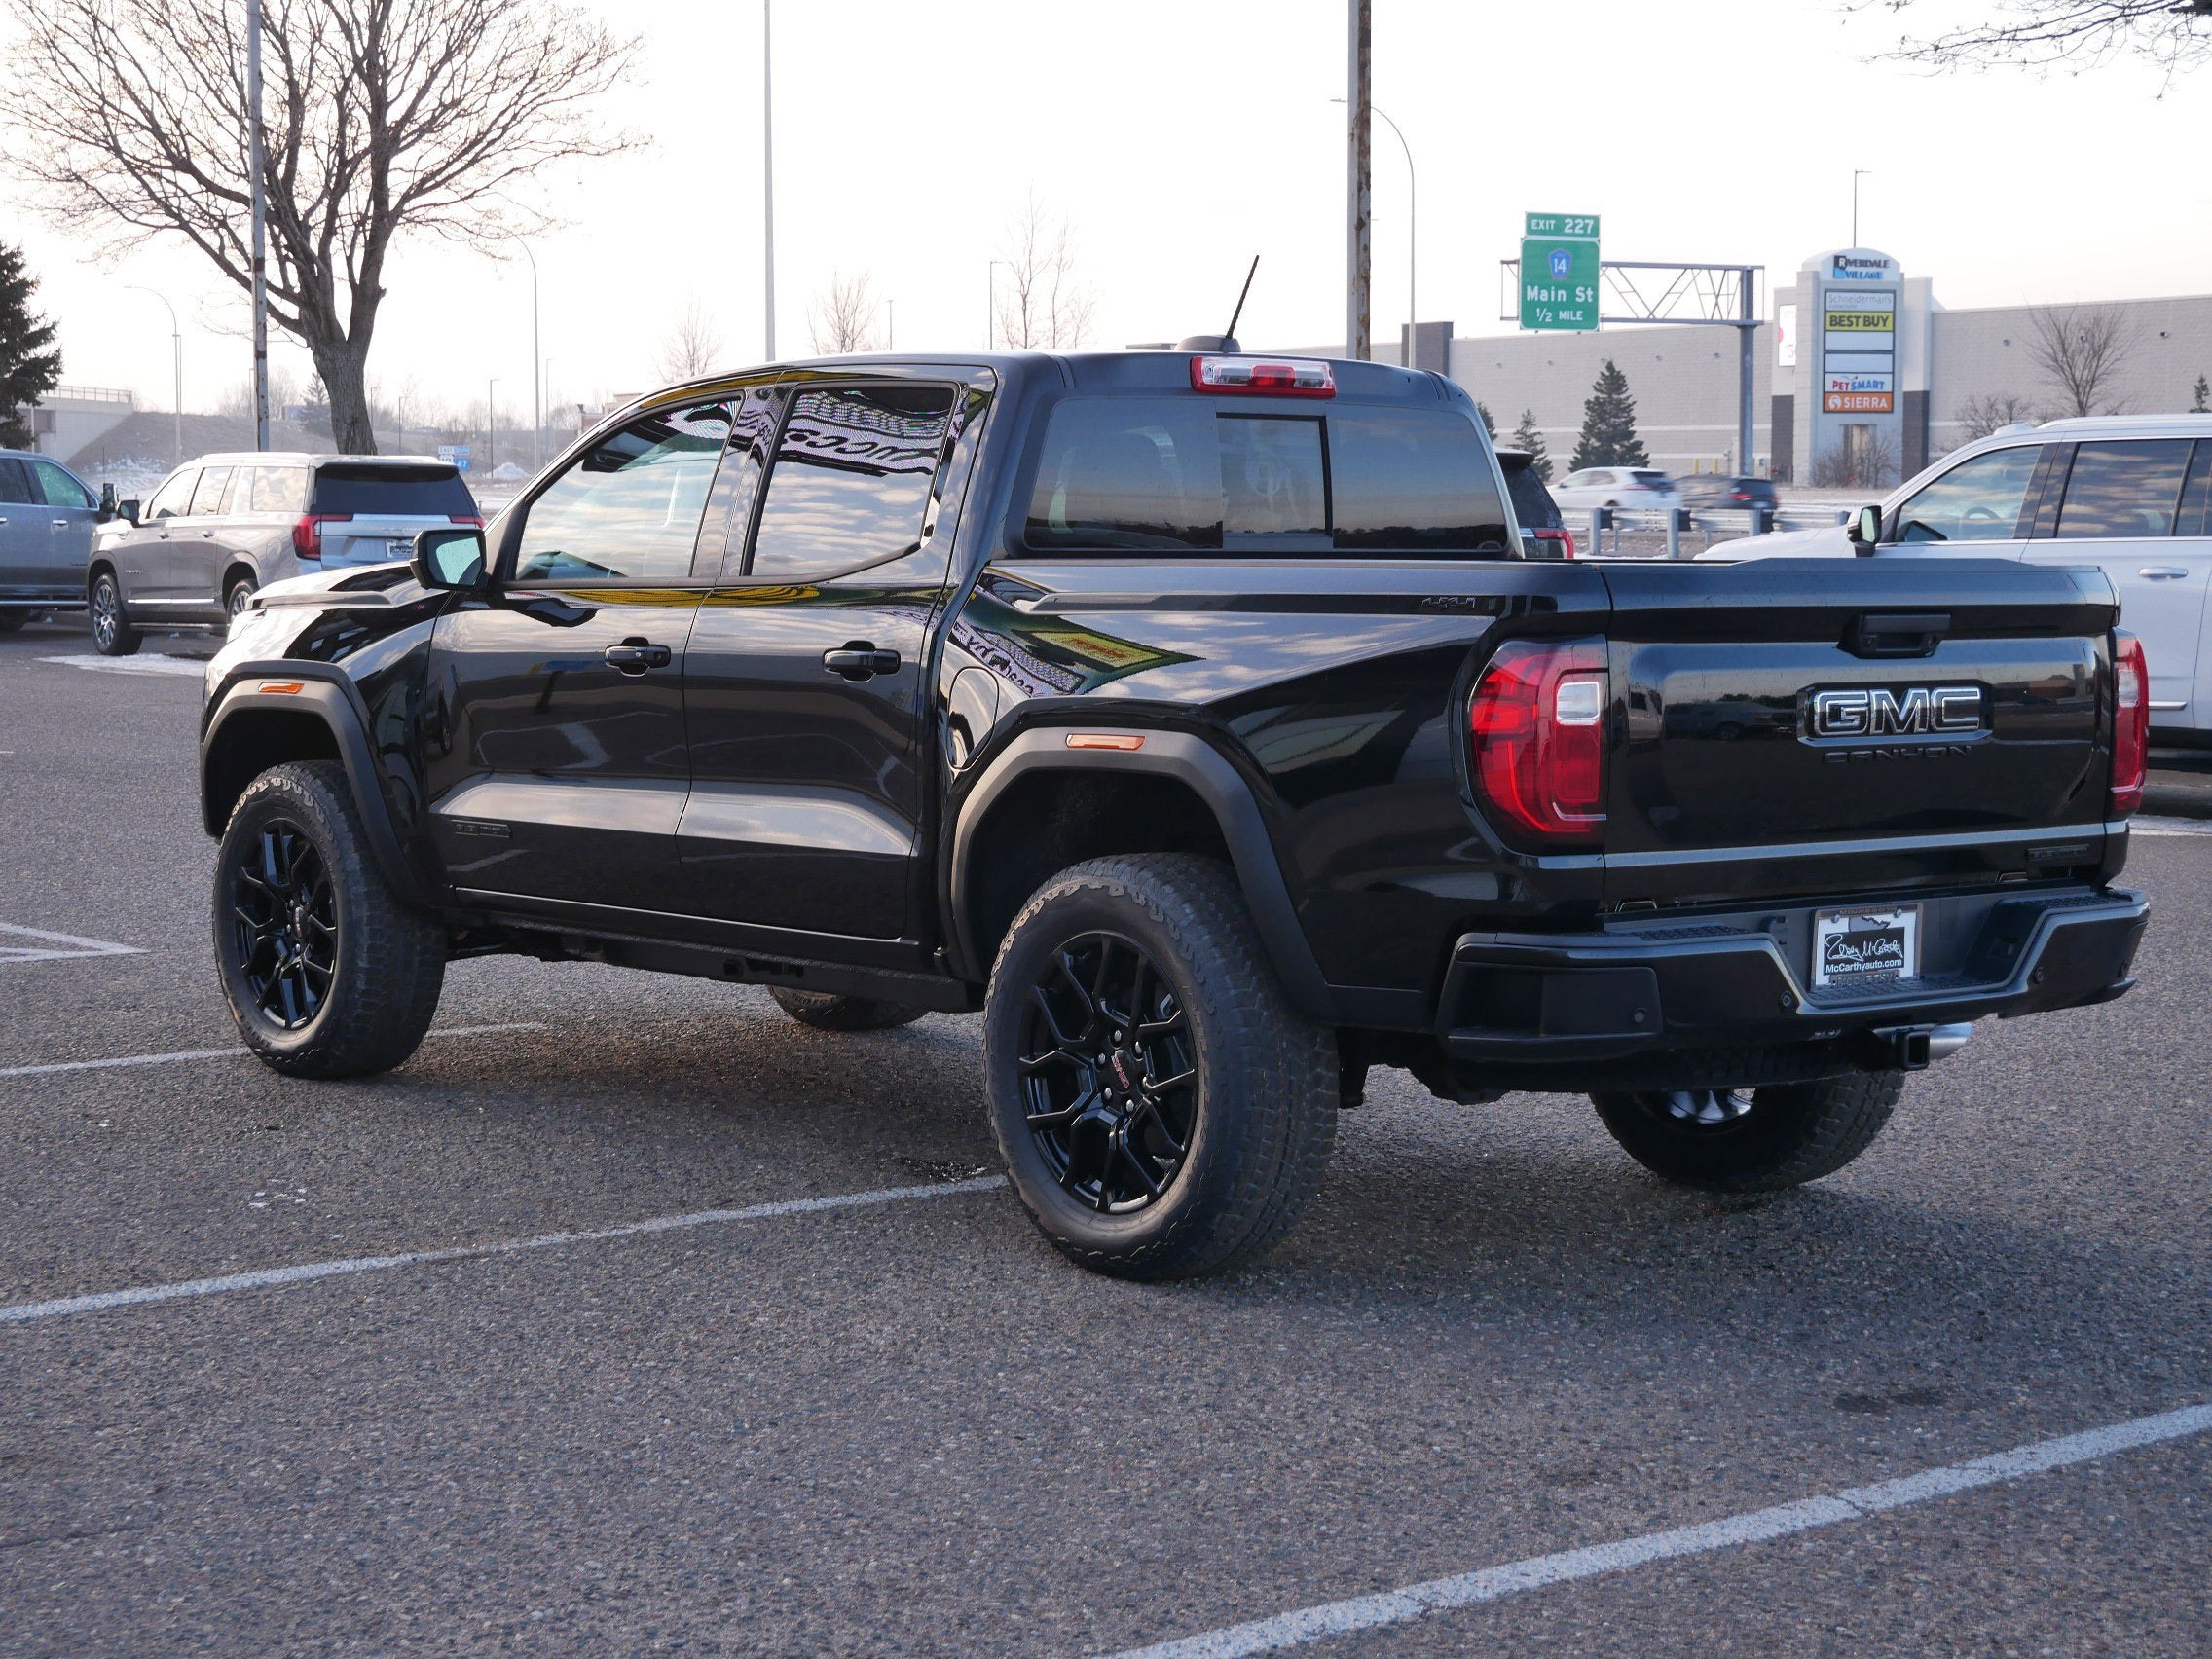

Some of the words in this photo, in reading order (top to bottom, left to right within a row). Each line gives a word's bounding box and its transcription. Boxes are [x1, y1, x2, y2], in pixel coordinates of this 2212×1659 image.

[1531, 219, 1556, 230] EXIT
[1564, 218, 1594, 234] 227
[1554, 258, 1566, 273] 14
[1838, 257, 1890, 268] RIVERDALE
[1845, 271, 1884, 279] VILLAGE
[1526, 285, 1567, 302] Main
[1575, 286, 1594, 302] St
[1559, 311, 1583, 321] MILE
[1829, 315, 1862, 327] BEST
[1862, 315, 1889, 327] BUY
[1844, 396, 1888, 409] SIERRA
[1814, 687, 1980, 736] GMC
[1825, 958, 1902, 974] McCarthyauto.com
